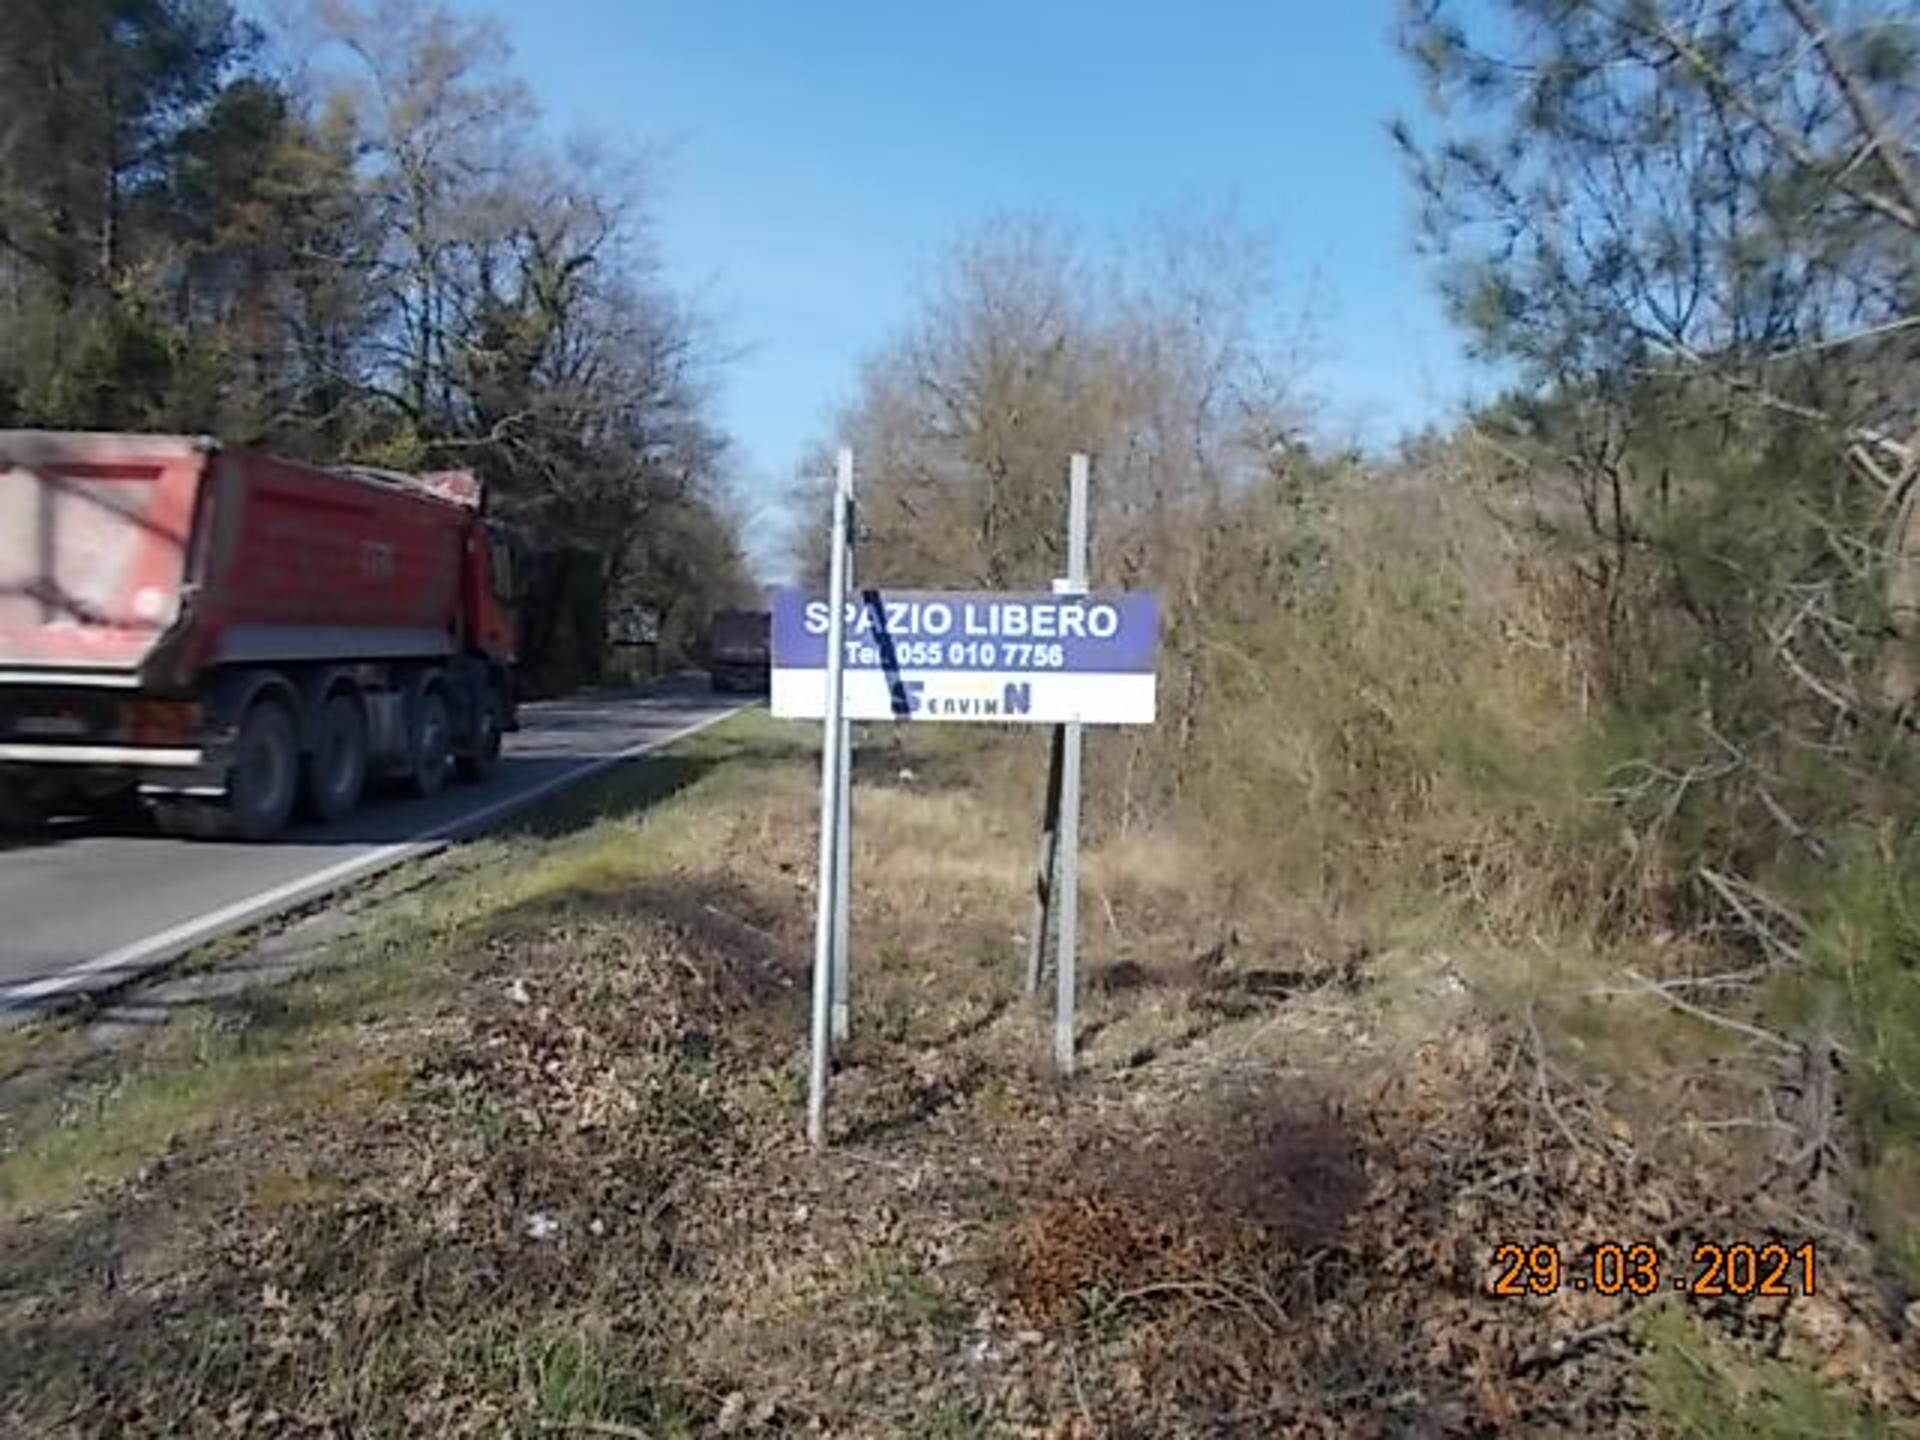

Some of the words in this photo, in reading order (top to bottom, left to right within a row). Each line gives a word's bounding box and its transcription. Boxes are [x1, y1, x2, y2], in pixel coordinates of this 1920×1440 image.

[804, 602, 952, 635] SPAZIO
[965, 603, 1118, 637] LIBERO
[897, 641, 942, 665] 055
[949, 642, 996, 666] 010
[1002, 643, 1064, 667] 7756
